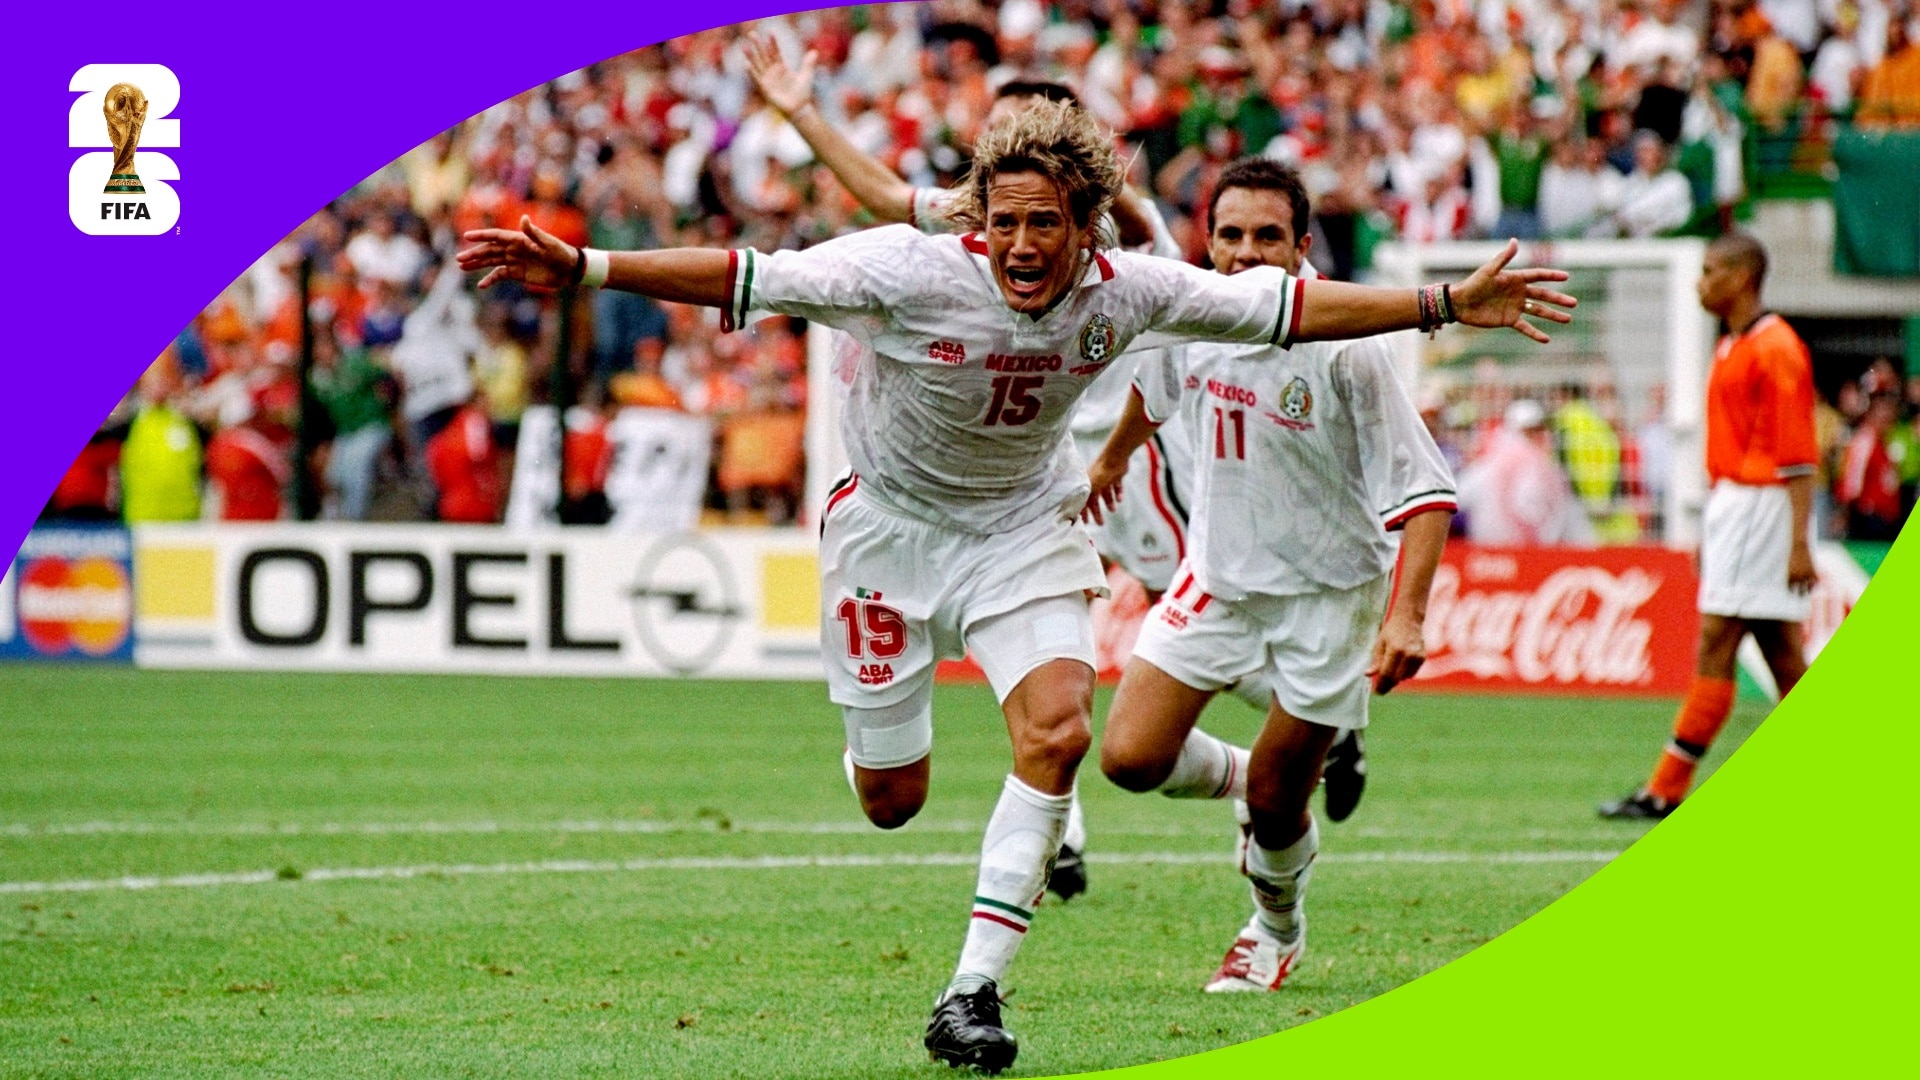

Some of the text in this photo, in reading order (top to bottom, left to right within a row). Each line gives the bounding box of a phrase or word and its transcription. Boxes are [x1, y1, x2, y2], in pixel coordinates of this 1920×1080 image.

[928, 350, 966, 365] SPORT
[929, 341, 966, 357] ABA
[985, 353, 1062, 373] MEXICO
[983, 375, 1046, 426] 15
[1207, 378, 1256, 408] MEXICO
[1214, 406, 1245, 460] 11
[238, 547, 622, 651] OPEL
[837, 598, 908, 660] 15
[858, 662, 895, 678] ABA
